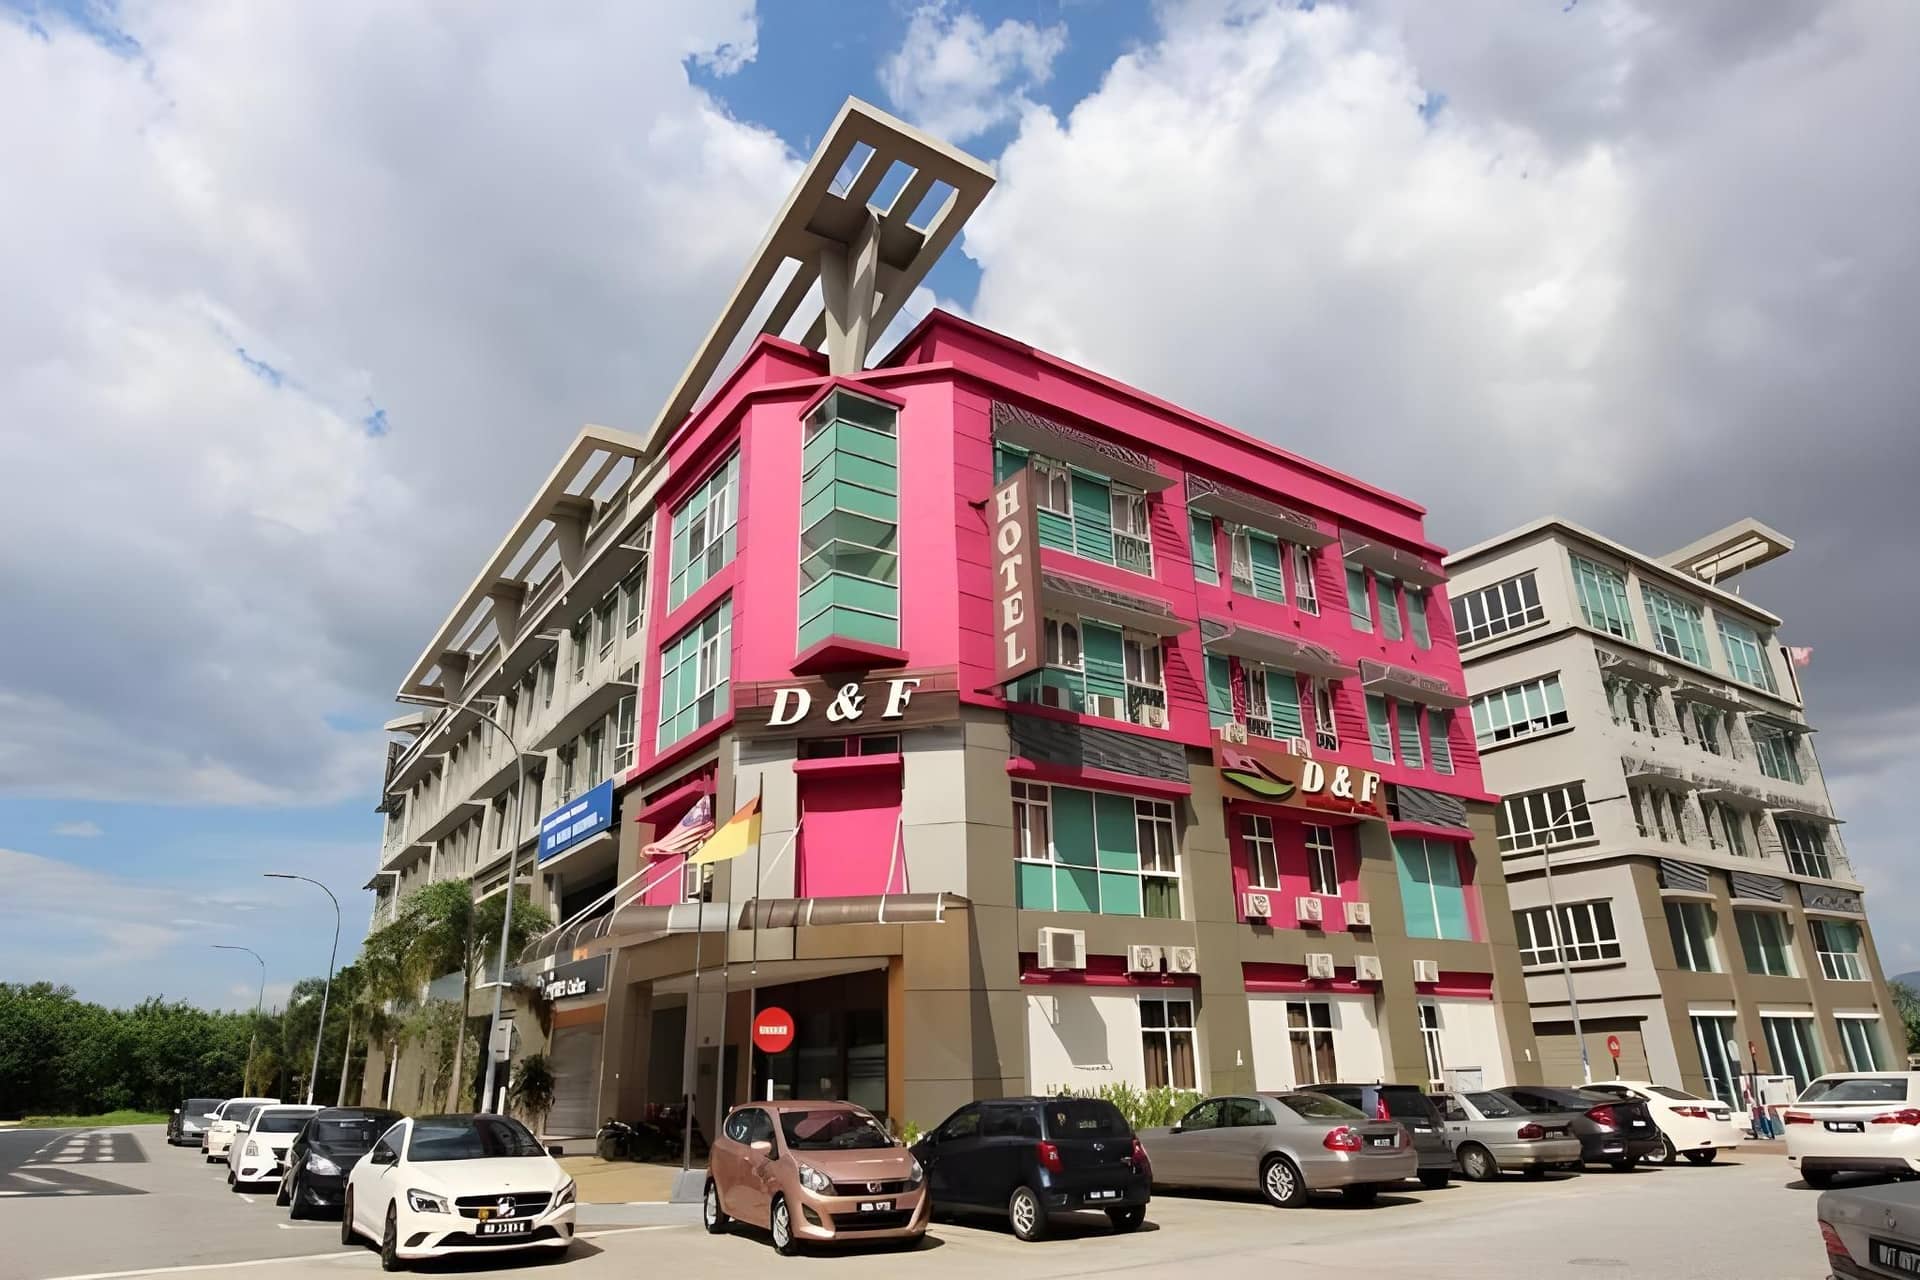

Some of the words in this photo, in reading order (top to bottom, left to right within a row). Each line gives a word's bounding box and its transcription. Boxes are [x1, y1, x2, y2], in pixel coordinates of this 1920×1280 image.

[996, 481, 1026, 669] HOTEL
[765, 688, 811, 726] D
[826, 683, 866, 722] &
[881, 679, 921, 718] F
[1301, 758, 1325, 793] D
[1331, 765, 1354, 799] &
[1360, 770, 1381, 803] F
